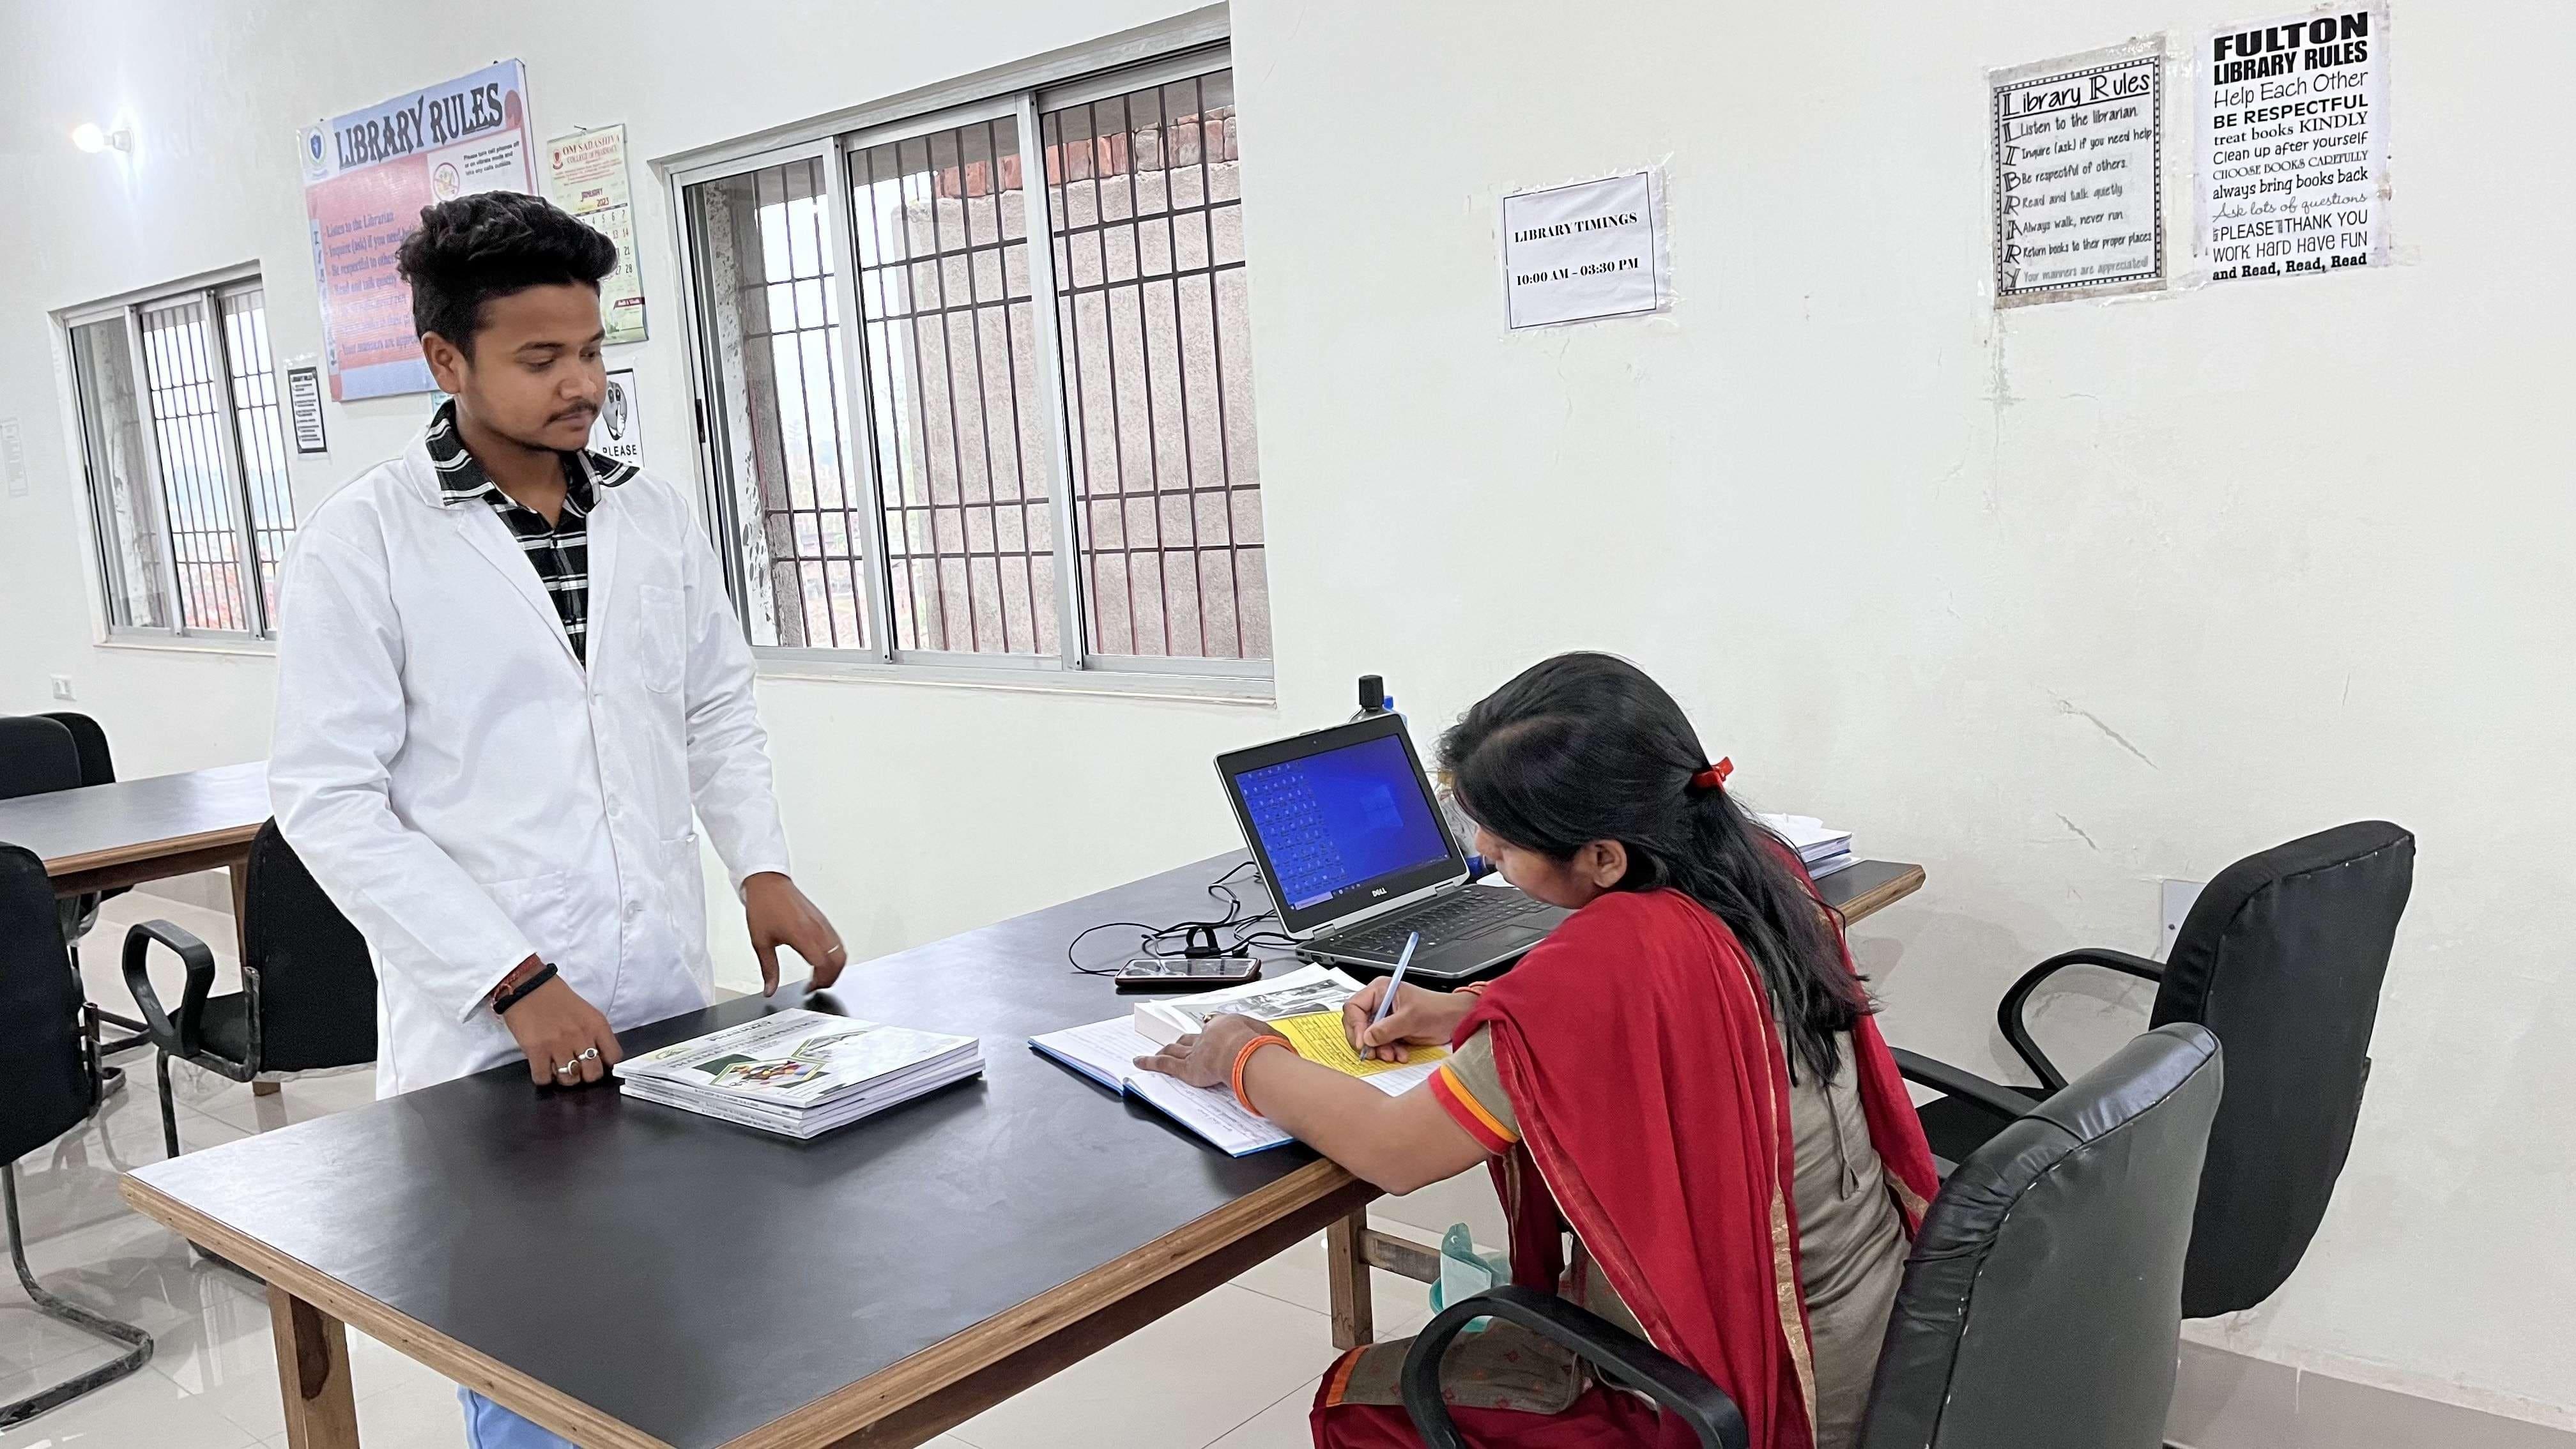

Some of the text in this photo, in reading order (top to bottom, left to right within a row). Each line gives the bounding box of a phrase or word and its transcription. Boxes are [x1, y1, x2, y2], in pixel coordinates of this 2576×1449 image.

[2214, 12, 2368, 62] FULTON
[2214, 40, 2368, 86] LIBRARY RULES
[2002, 72, 2150, 116] Library Rules
[2214, 71, 2368, 109] Help Each Other
[334, 82, 503, 170] LIBRARY RULES
[2020, 121, 2050, 135] Listen
[2056, 118, 2066, 130] to
[2071, 112, 2088, 126] the
[2214, 94, 2368, 129] BE RESPECTFUL
[2214, 111, 2368, 146] treat books KINDLY
[2022, 146, 2050, 160] Inquire
[2055, 139, 2076, 152] (ask)
[2090, 138, 2104, 150] you
[2108, 130, 2129, 144] need
[2213, 131, 2368, 165] Clean up after yourself
[2022, 172, 2032, 184] Be
[2035, 164, 2079, 182] respectful
[2083, 164, 2092, 174] of
[2212, 150, 2369, 181] CHOOSE BOOKS CAREFULLY
[2022, 195, 2045, 208] Read
[2049, 192, 2066, 204] and
[2070, 188, 2088, 201] talk
[2093, 183, 2123, 197] quietly
[2212, 165, 2368, 199] always bring books back
[2023, 222, 2050, 233] Always
[2055, 216, 2076, 229] walk,
[2080, 213, 2104, 224] never
[2108, 211, 2123, 221] run
[2212, 193, 2368, 222] Ask lots of questions
[1514, 212, 1637, 243] LIBRARY TIMINGS
[2221, 220, 2274, 242] PLEASE
[2285, 213, 2333, 233] THANK
[2337, 209, 2368, 227] YOU
[624, 246, 630, 256] 21
[2023, 247, 2046, 258] Return
[2049, 243, 2069, 254] books
[2072, 241, 2080, 251] to
[2102, 236, 2125, 249] proper
[625, 264, 632, 273] 28
[1517, 272, 1548, 286] 10:00
[1551, 268, 1569, 281] AM
[1580, 262, 1615, 276] 03:30
[1619, 257, 1639, 270] PM
[2024, 272, 2038, 282] Your
[2043, 268, 2076, 280] manners
[2080, 266, 2094, 275] are
[2212, 252, 2367, 280] and Read, Read, Read
[603, 445, 637, 457] PLEASE
